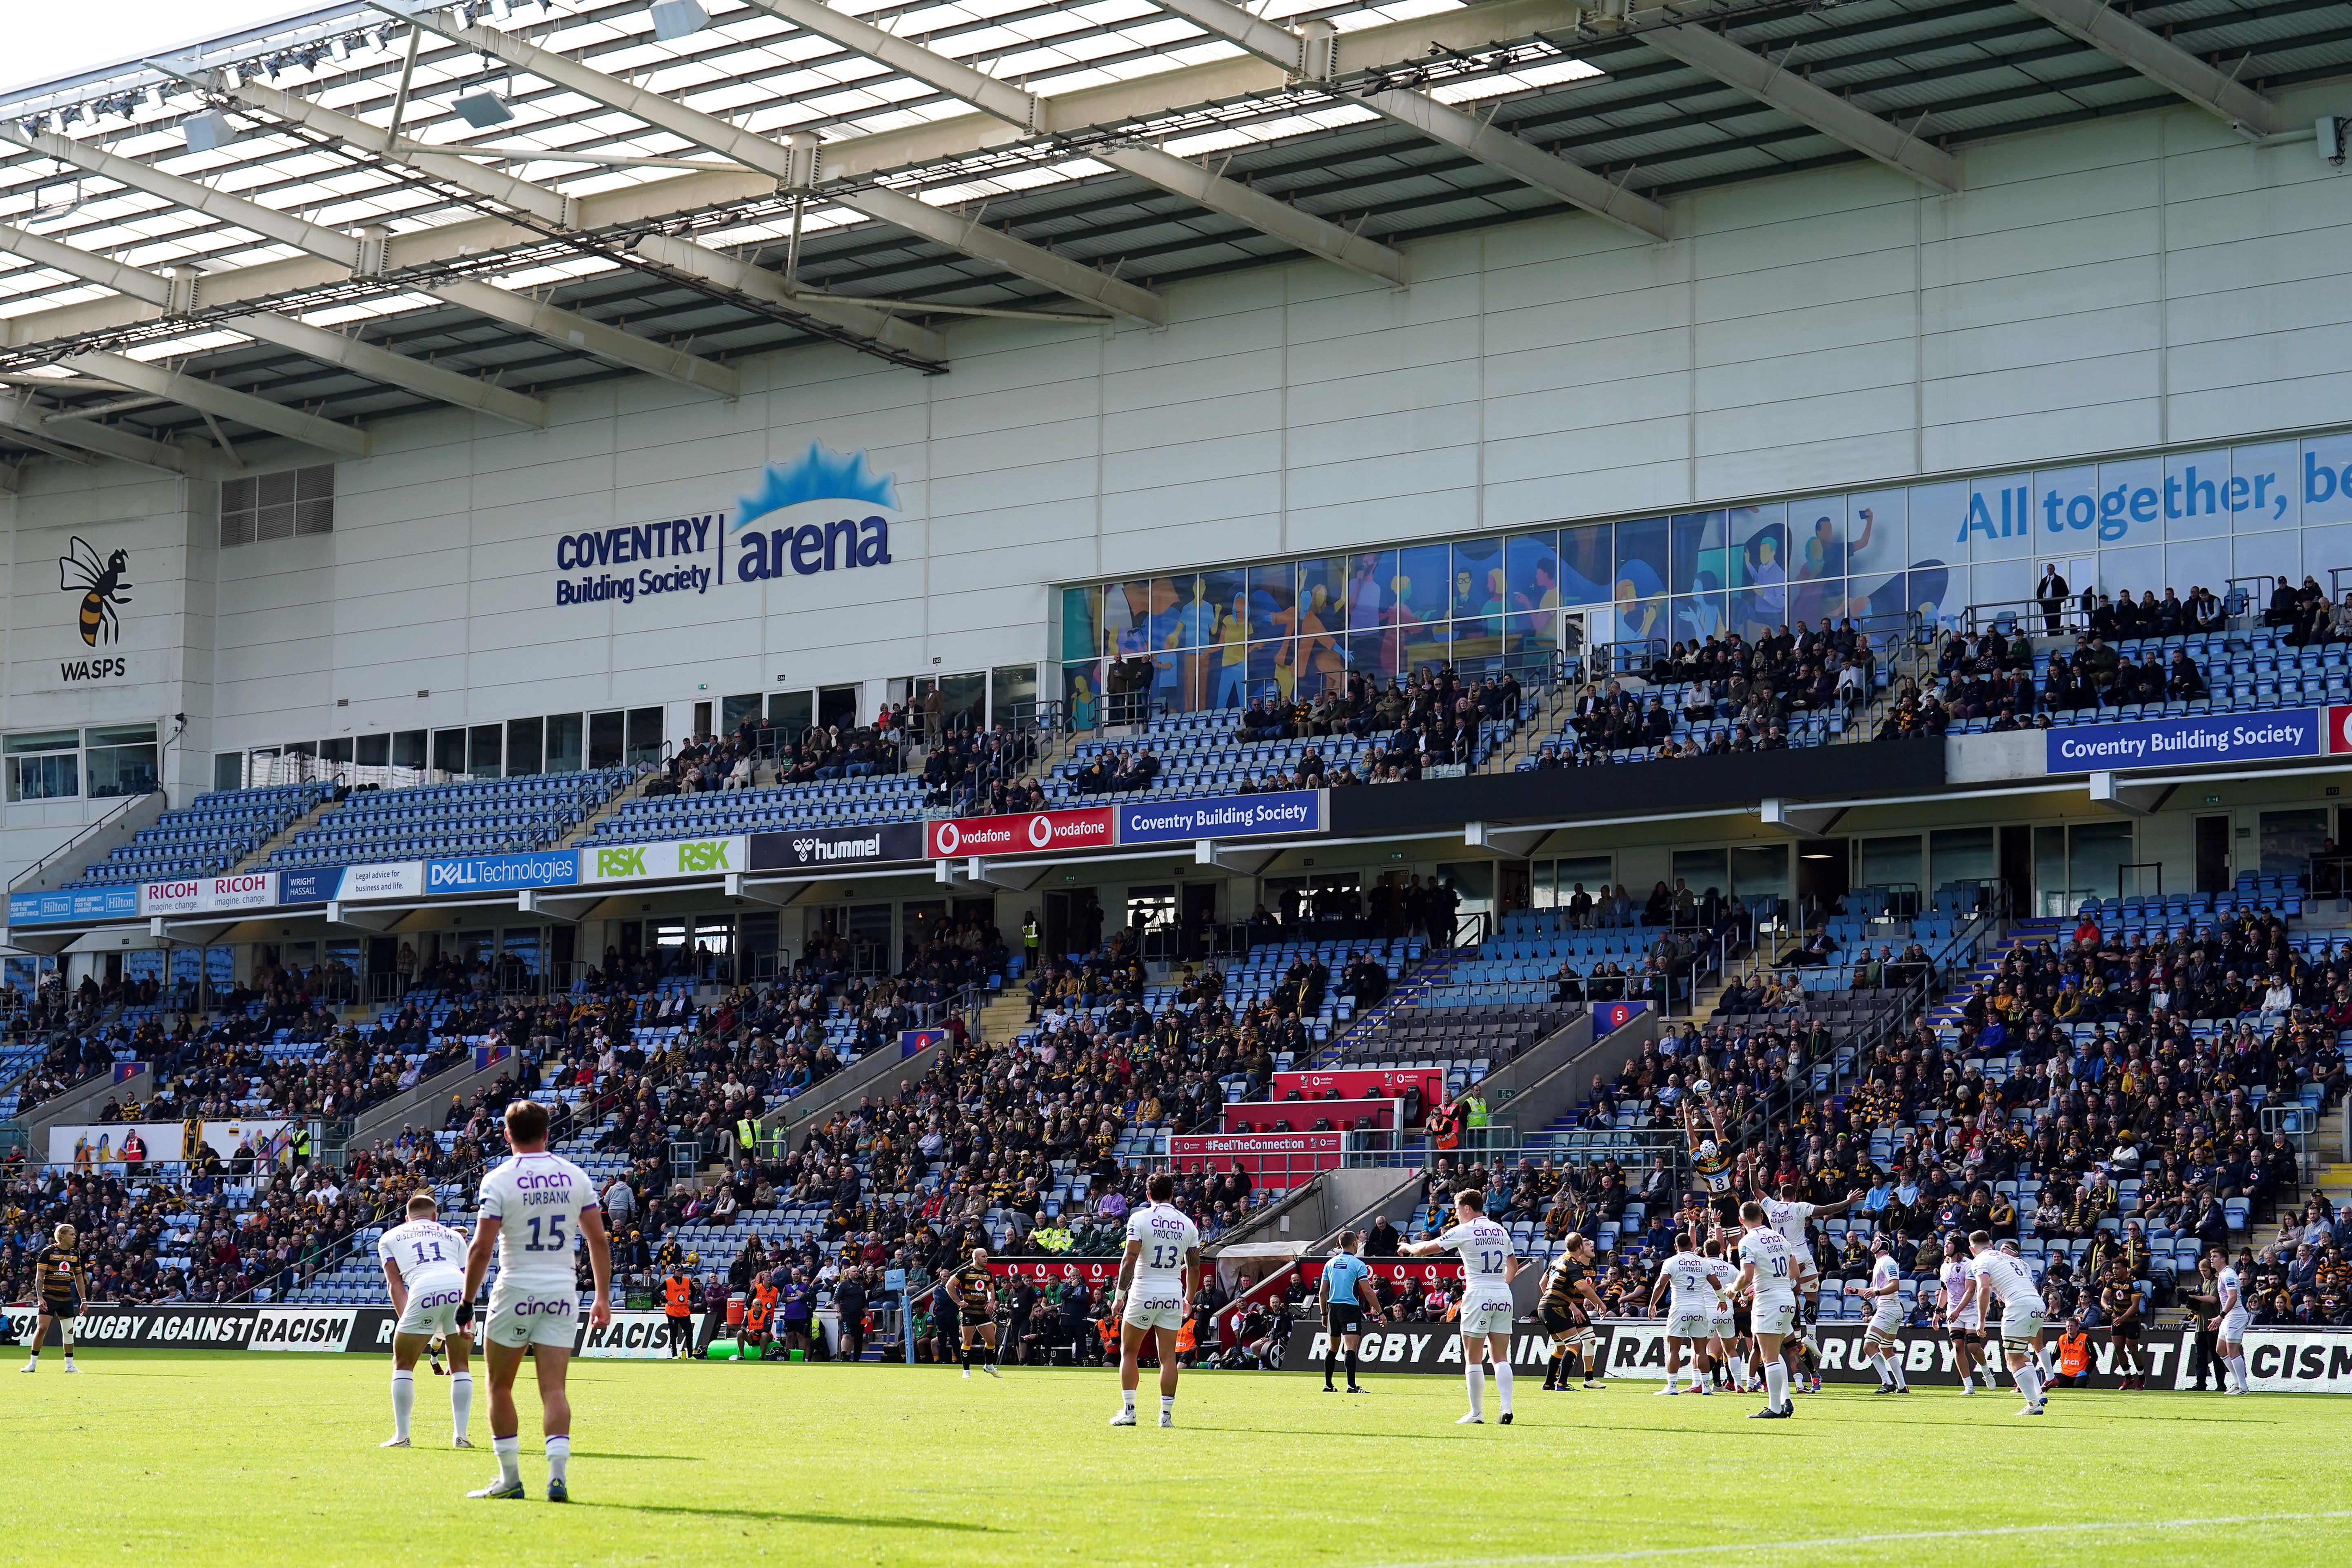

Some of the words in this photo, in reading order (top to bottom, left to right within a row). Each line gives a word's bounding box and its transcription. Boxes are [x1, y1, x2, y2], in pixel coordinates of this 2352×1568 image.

[1956, 485, 2028, 543] All
[2042, 464, 2287, 542] together,
[557, 515, 712, 571] COVENTRY
[738, 515, 892, 582] arena
[557, 574, 634, 605] Building
[639, 564, 711, 594] Society
[61, 657, 126, 681] WASPS
[2061, 739, 2146, 758] Coventry
[2151, 729, 2229, 752] Building
[2233, 723, 2304, 747] Society
[1131, 814, 1194, 831] Coventry
[1196, 807, 1254, 827] Building
[1256, 803, 1308, 822] Society
[961, 829, 1010, 844] vodafone
[1054, 821, 1105, 837] vodafone
[815, 833, 880, 860] hummel
[597, 847, 647, 878] RSK
[678, 840, 730, 872] RSK
[356, 872, 371, 881] Legal
[372, 870, 390, 878] advice
[431, 862, 476, 885] DELL
[476, 857, 572, 884] Technologies
[215, 876, 266, 894] RICOH
[290, 877, 315, 886] WRIGHT
[355, 884, 379, 892] business
[393, 881, 404, 889] life.
[149, 882, 197, 899] RICOH
[290, 887, 316, 896] HASSALL
[44, 902, 68, 913] Hilton
[109, 897, 133, 909] Hilton
[149, 903, 173, 913] imagine.
[175, 900, 198, 911] change.
[215, 897, 240, 907] imagine.
[242, 894, 266, 905] change.
[1616, 1011, 1623, 1021] 5
[920, 1038, 926, 1047] 4
[126, 1069, 133, 1077] 2
[1206, 1137, 1304, 1151] #FeelTheConnection
[517, 1170, 572, 1189] cinch
[1715, 1178, 1725, 1190] 8
[523, 1191, 570, 1206] FURBANK
[1151, 1215, 1185, 1231] cinch
[525, 1214, 566, 1252] 15
[1153, 1229, 1183, 1241] PROCTOR
[1473, 1226, 1504, 1236] cinch
[1475, 1238, 1504, 1246] DINGWALL
[1760, 1234, 1784, 1244] cinch
[412, 1242, 446, 1265] 11
[1150, 1245, 1178, 1269] 13
[1481, 1250, 1503, 1273] 12
[1679, 1258, 1701, 1266] cinch
[1711, 1263, 1729, 1271] inch
[1771, 1256, 1788, 1278] 10
[2010, 1262, 2024, 1277] 8
[1686, 1276, 1695, 1291] 2
[514, 1295, 570, 1316] cinch
[1143, 1296, 1180, 1309] cinch
[1481, 1299, 1511, 1313] cinch
[1681, 1312, 1703, 1322] cinch
[1712, 1316, 1732, 1324] cinch
[73, 1315, 147, 1340] RUGBY
[146, 1317, 254, 1341] AGAINST
[255, 1318, 348, 1343] RACISM
[1308, 1332, 1433, 1363] RGBY
